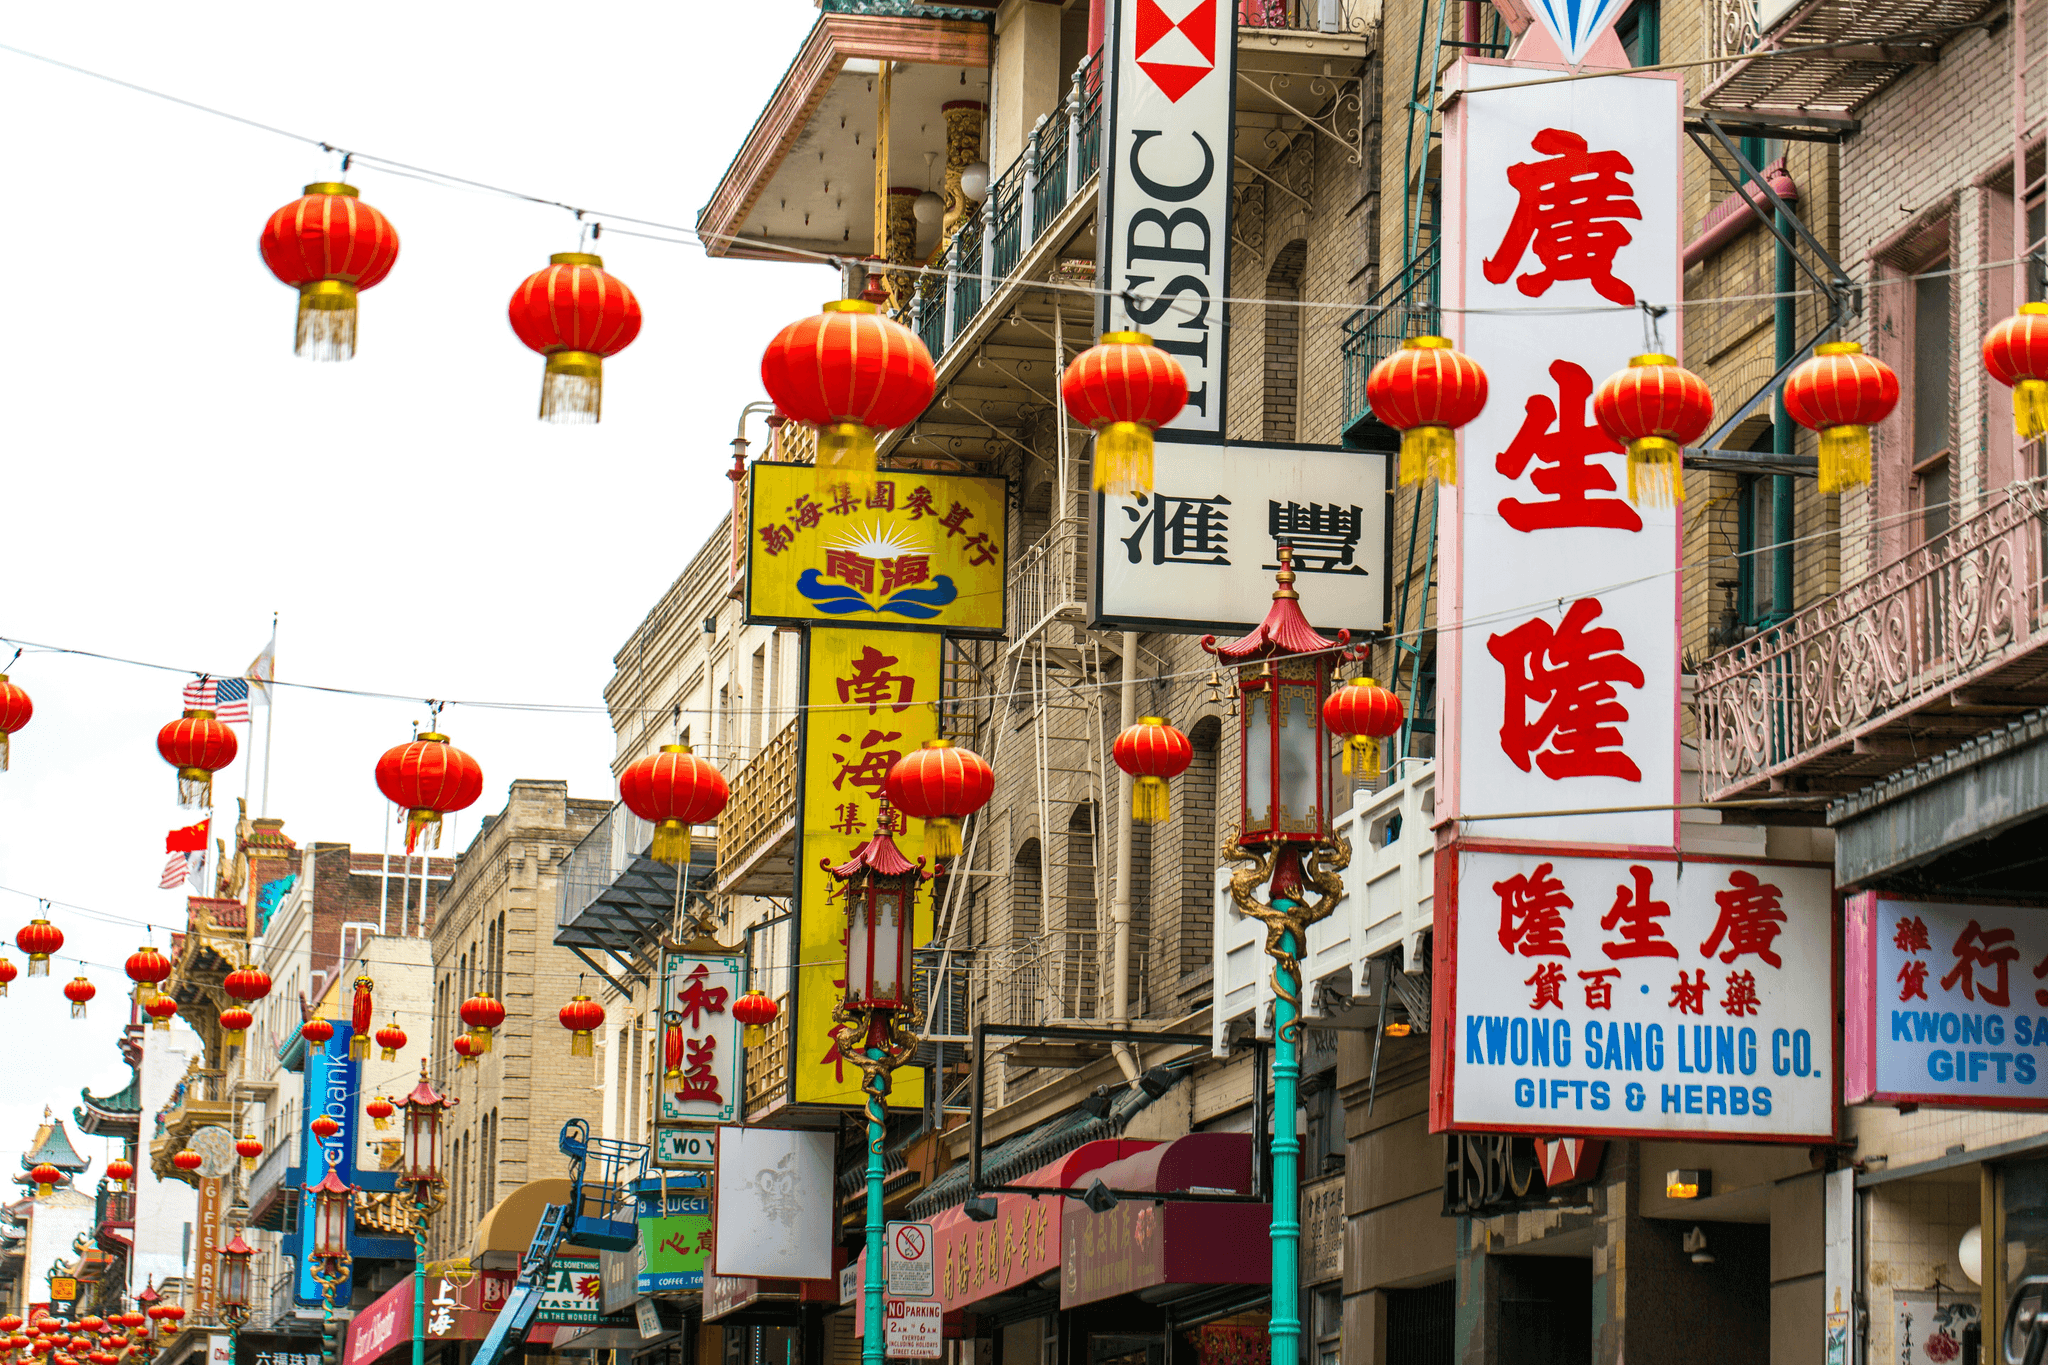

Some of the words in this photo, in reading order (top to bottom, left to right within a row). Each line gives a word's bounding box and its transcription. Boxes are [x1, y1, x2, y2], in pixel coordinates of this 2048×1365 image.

[1483, 128, 1644, 783] 廣生隆
[758, 481, 1000, 567] 南海集團參茸行
[826, 549, 929, 596] 南海
[677, 963, 729, 1106] 和益
[1892, 1010, 2005, 1046] KWONG
[1466, 1015, 1572, 1068] KWONG
[1585, 1020, 1664, 1073] SANG
[1678, 1024, 1757, 1077] LUNG
[1772, 1028, 1822, 1079] CO.
[1927, 1050, 2037, 1085] GIFTS
[1514, 1078, 1611, 1112] GIFTS
[1625, 1082, 1647, 1113] &
[1661, 1084, 1773, 1117] HERBS
[673, 1138, 700, 1155] WO
[203, 1186, 217, 1248] GIFTS
[657, 1198, 705, 1213] SWEET
[564, 1261, 599, 1270] SOMETHING
[659, 1277, 684, 1286] COFFEE
[200, 1263, 214, 1316] ARTS
[428, 1279, 456, 1336] 上海
[551, 1312, 565, 1320] THE
[567, 1313, 598, 1322] WONDER
[888, 1302, 903, 1318] NO
[905, 1306, 939, 1318] PARKING
[890, 1322, 897, 1333] 2
[919, 1322, 926, 1333] 6
